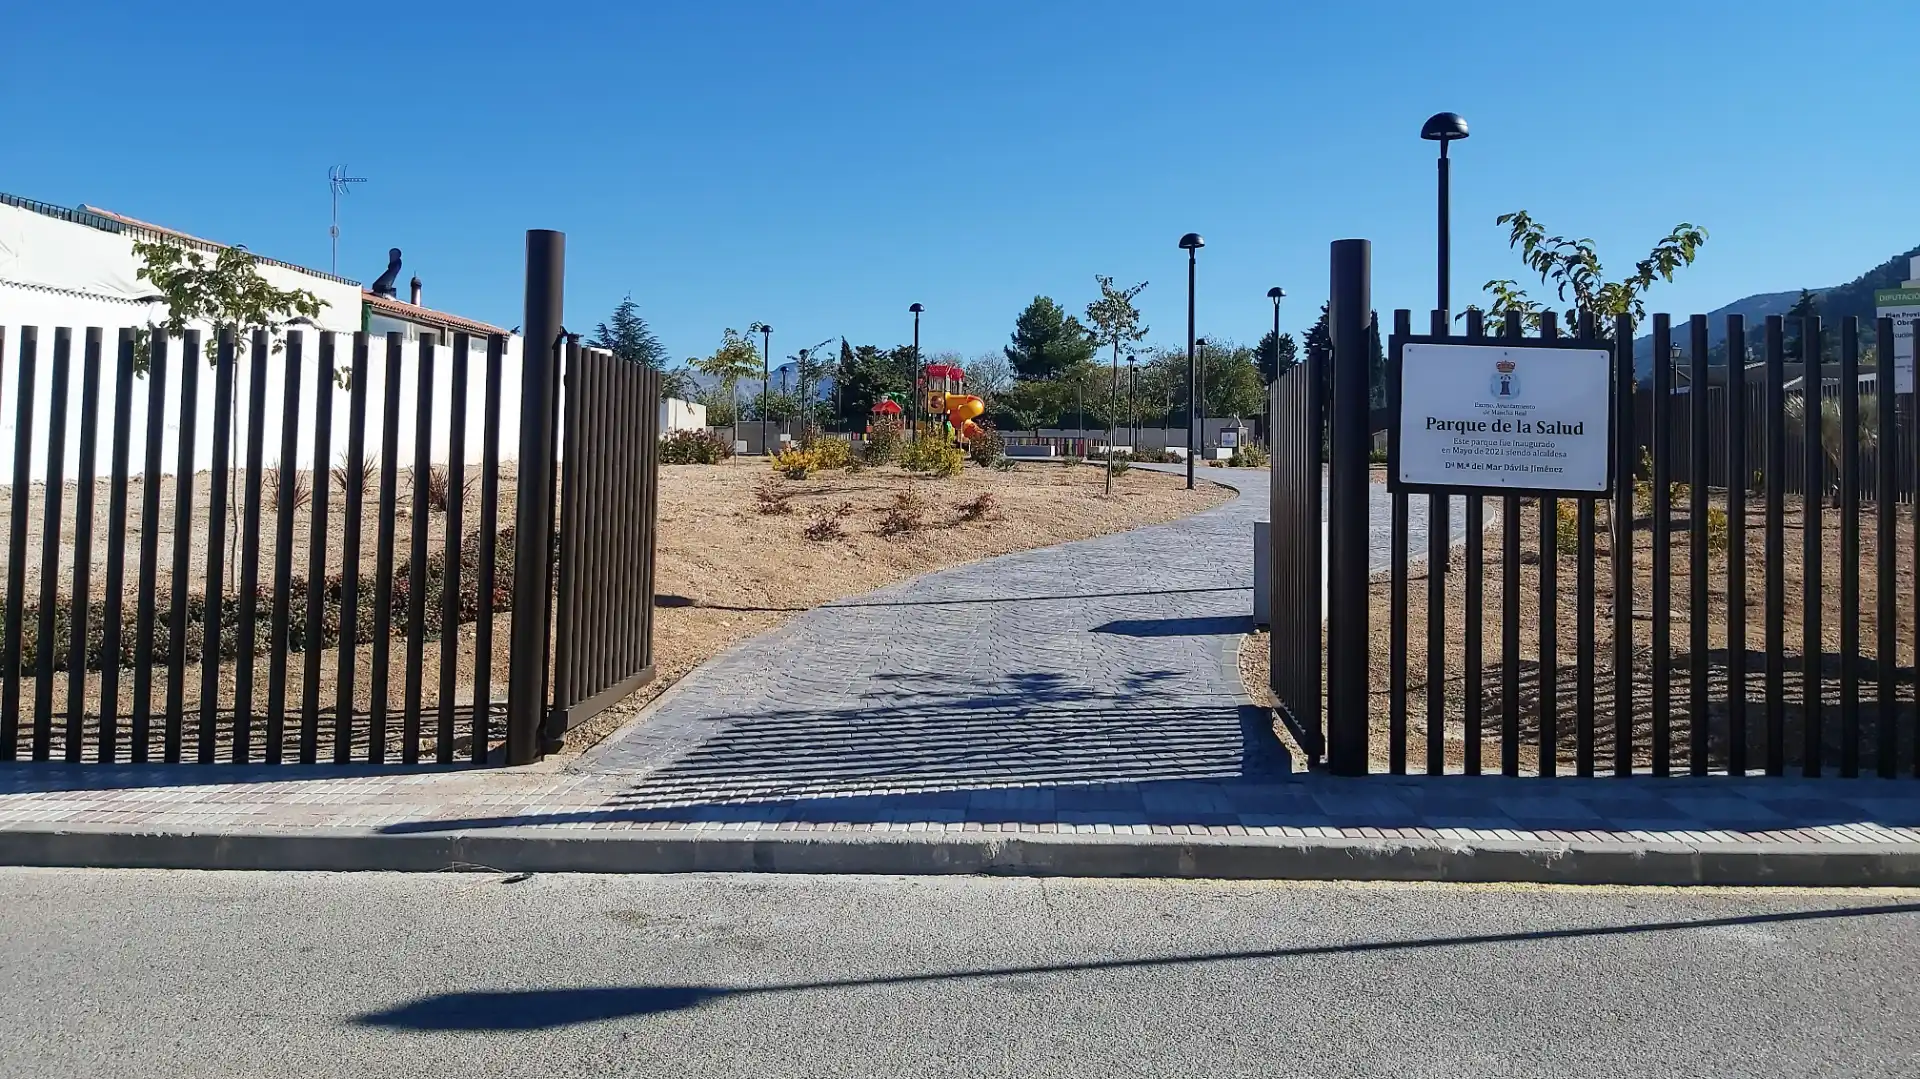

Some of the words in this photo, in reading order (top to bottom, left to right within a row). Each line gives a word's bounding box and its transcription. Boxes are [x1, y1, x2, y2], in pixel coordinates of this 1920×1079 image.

[1426, 417, 1486, 435] Parque
[1491, 419, 1512, 433] de
[1516, 420, 1531, 434] la
[1536, 420, 1584, 435] Salud
[1471, 439, 1497, 448] parque
[1499, 439, 1511, 447] fue
[1512, 440, 1555, 449] inaugurado
[1452, 447, 1472, 456] Mayo
[1474, 447, 1483, 455] de
[1485, 448, 1504, 456] 2021
[1506, 449, 1531, 457] siendo
[1532, 450, 1567, 458] alcaldesa
[1471, 462, 1484, 470] del
[1485, 463, 1502, 471] Mar
[1504, 463, 1529, 472] Dávila
[1530, 464, 1563, 473] Jiménez
